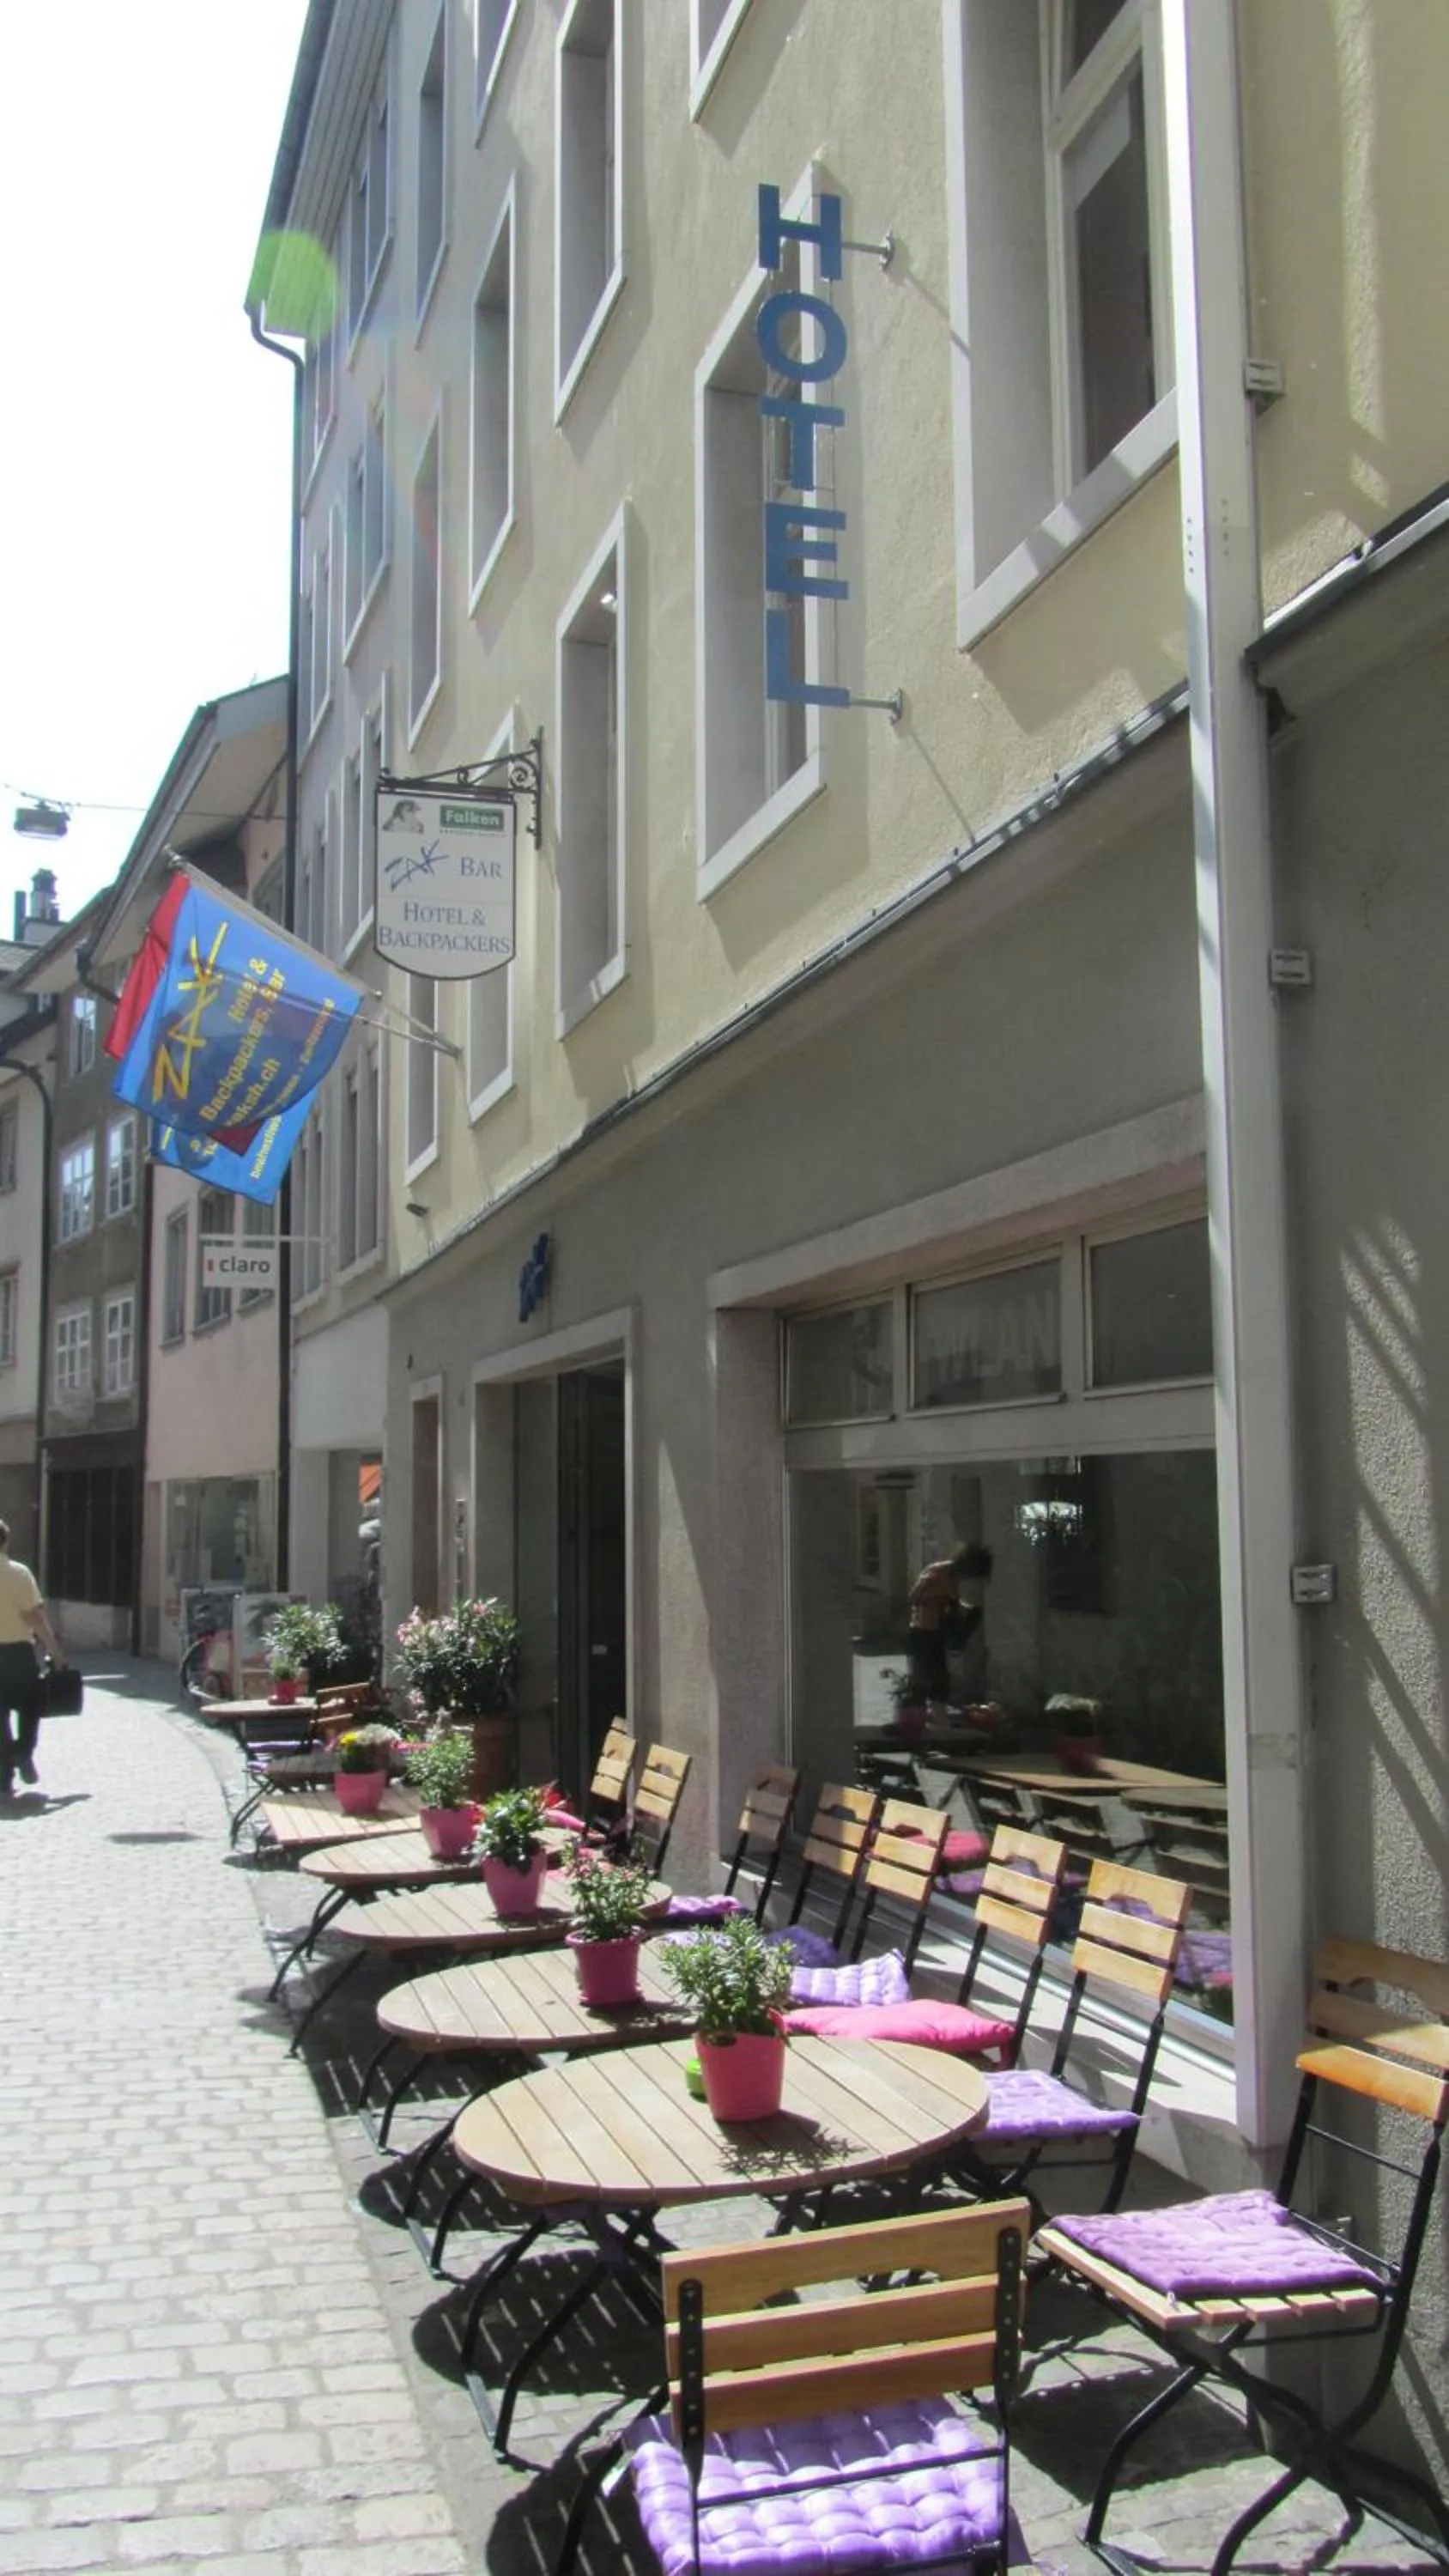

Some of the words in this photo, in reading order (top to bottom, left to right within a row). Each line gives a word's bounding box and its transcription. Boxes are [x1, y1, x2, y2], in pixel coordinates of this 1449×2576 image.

[757, 183, 851, 709] HOTEL
[446, 810, 500, 826] Falken
[460, 856, 503, 879] BAR
[403, 902, 469, 926] HOTEL
[471, 908, 487, 926] &
[379, 926, 511, 954] BACKPACKERS
[227, 973, 258, 1024] Hotel
[249, 957, 268, 975] &
[219, 1255, 271, 1273] claro
